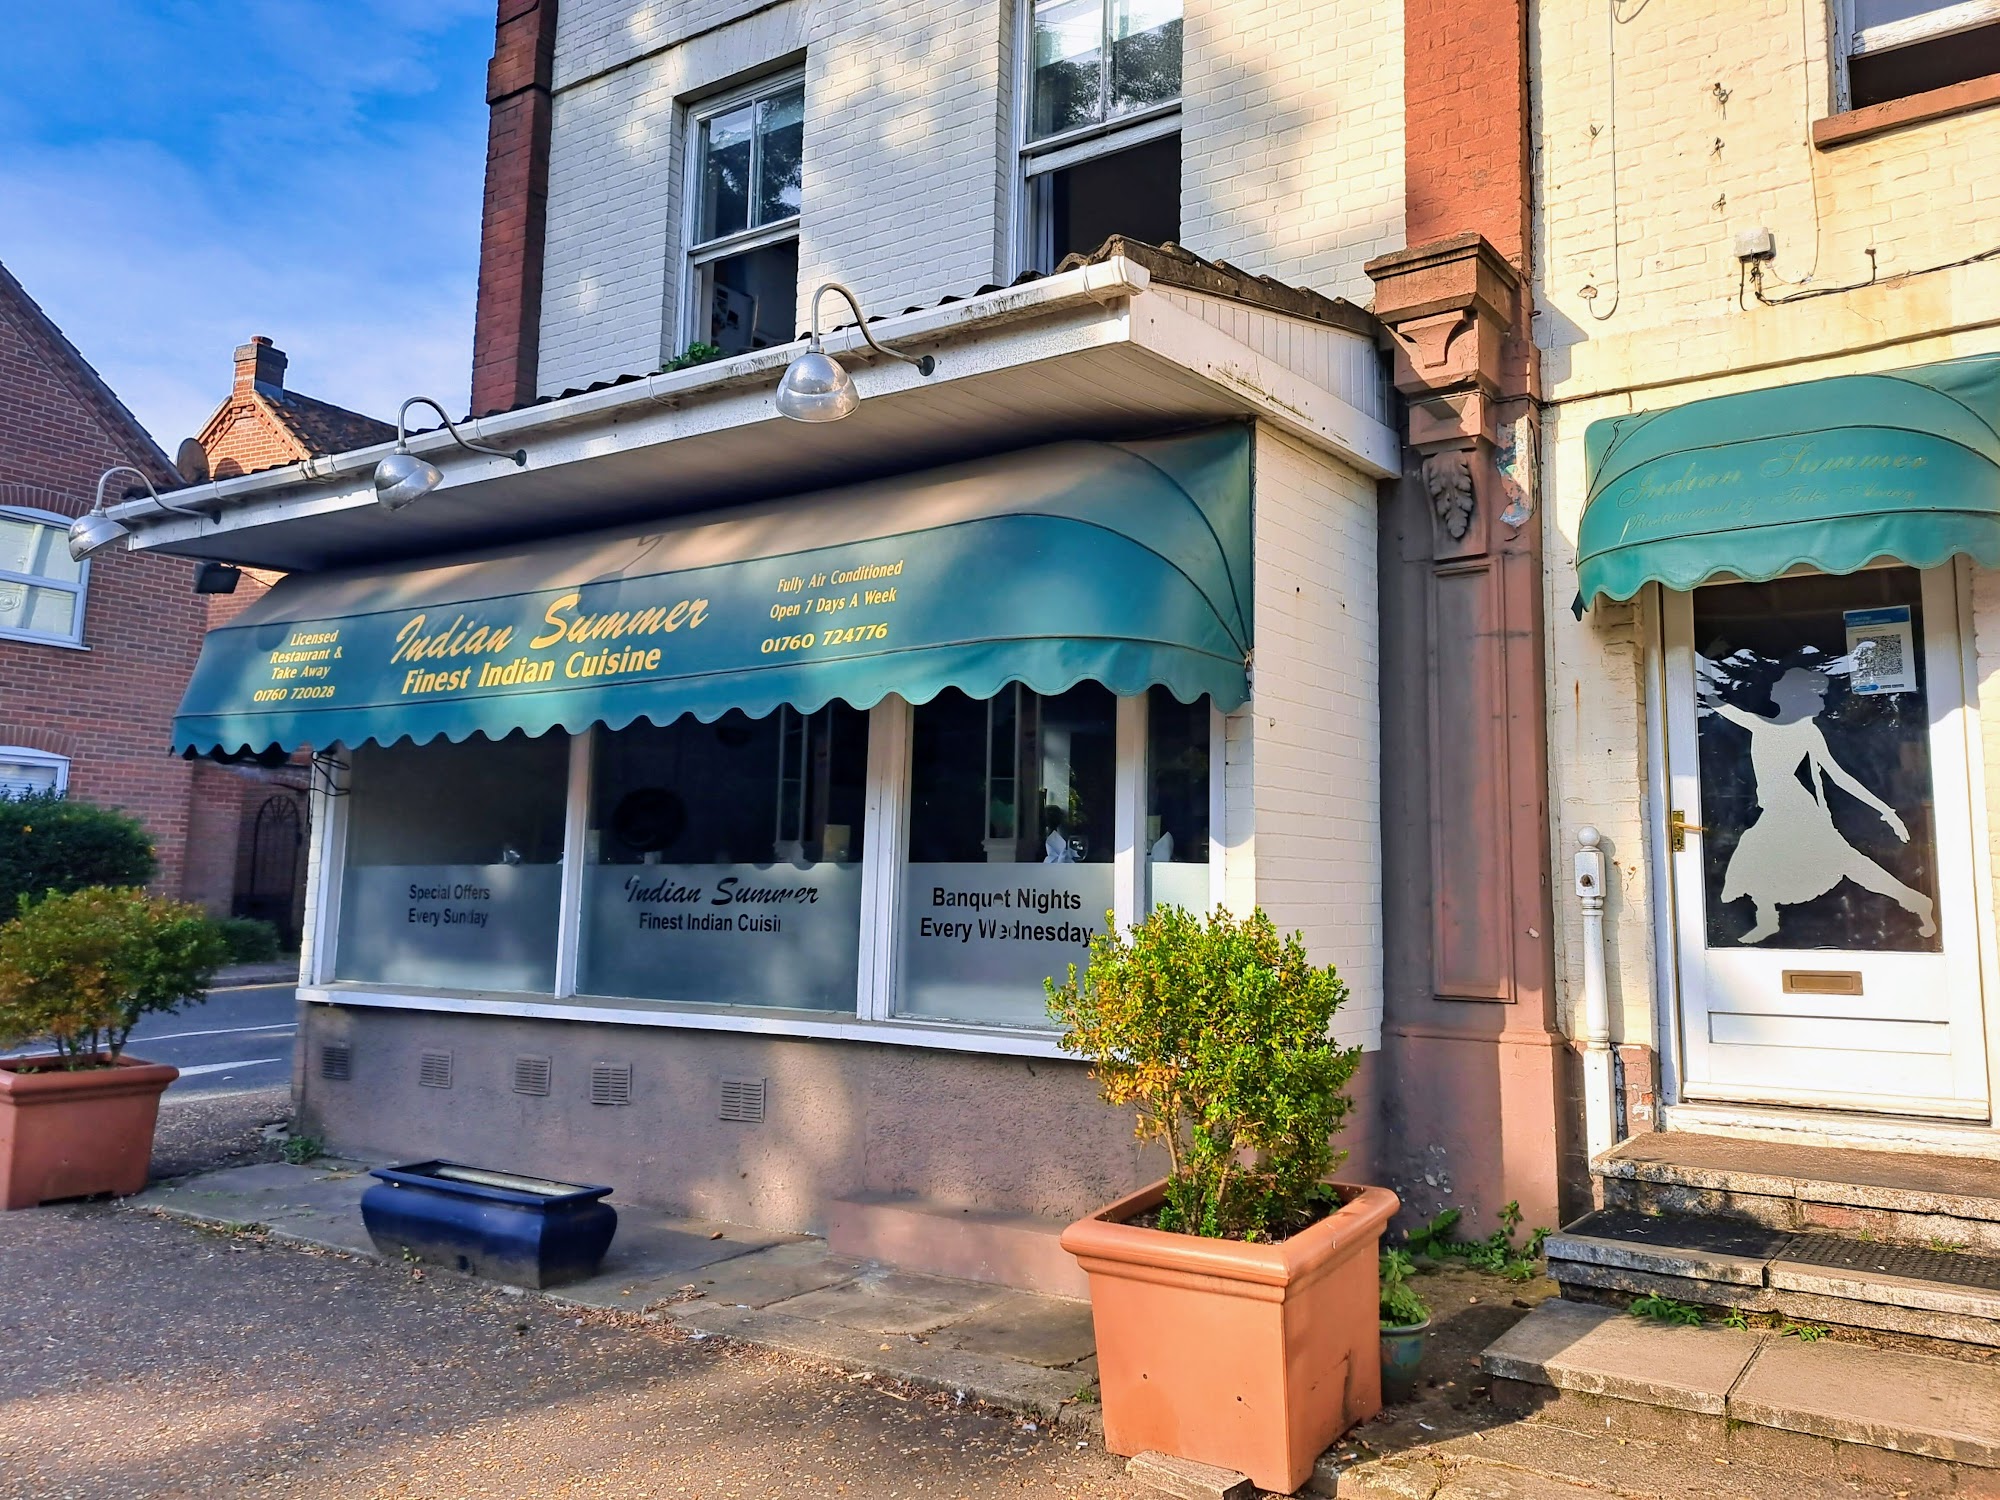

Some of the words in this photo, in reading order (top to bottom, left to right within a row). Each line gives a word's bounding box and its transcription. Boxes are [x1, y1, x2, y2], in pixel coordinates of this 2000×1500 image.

[777, 576, 806, 594] Fully
[808, 572, 827, 589] Air
[830, 560, 904, 585] Conditioned
[769, 604, 801, 622] Open
[805, 599, 813, 614] 7
[816, 596, 846, 615] Days
[849, 592, 858, 608] A
[864, 587, 897, 606] Week
[290, 629, 340, 647] Licensed
[390, 613, 514, 664] Indian
[529, 593, 710, 650] Summer
[760, 633, 816, 654] 01760
[822, 623, 888, 646] 724776
[269, 648, 331, 664] Restaurant
[333, 645, 343, 659] &
[271, 666, 298, 680] Take
[300, 665, 331, 680] Away
[401, 665, 472, 695] Finest
[477, 652, 556, 688] Indian
[565, 645, 662, 679] Cuisine
[253, 688, 288, 702] 01760
[290, 685, 336, 700] 720028
[409, 884, 451, 902] Special
[454, 884, 491, 900] Offers
[624, 875, 702, 903] Indian
[932, 887, 1011, 912] Banquet
[1017, 888, 1081, 914] Nights
[408, 907, 440, 927] Every
[443, 908, 489, 928] Sunday
[639, 912, 683, 930] Finest
[687, 913, 733, 931] Indian
[920, 917, 973, 943] Every
